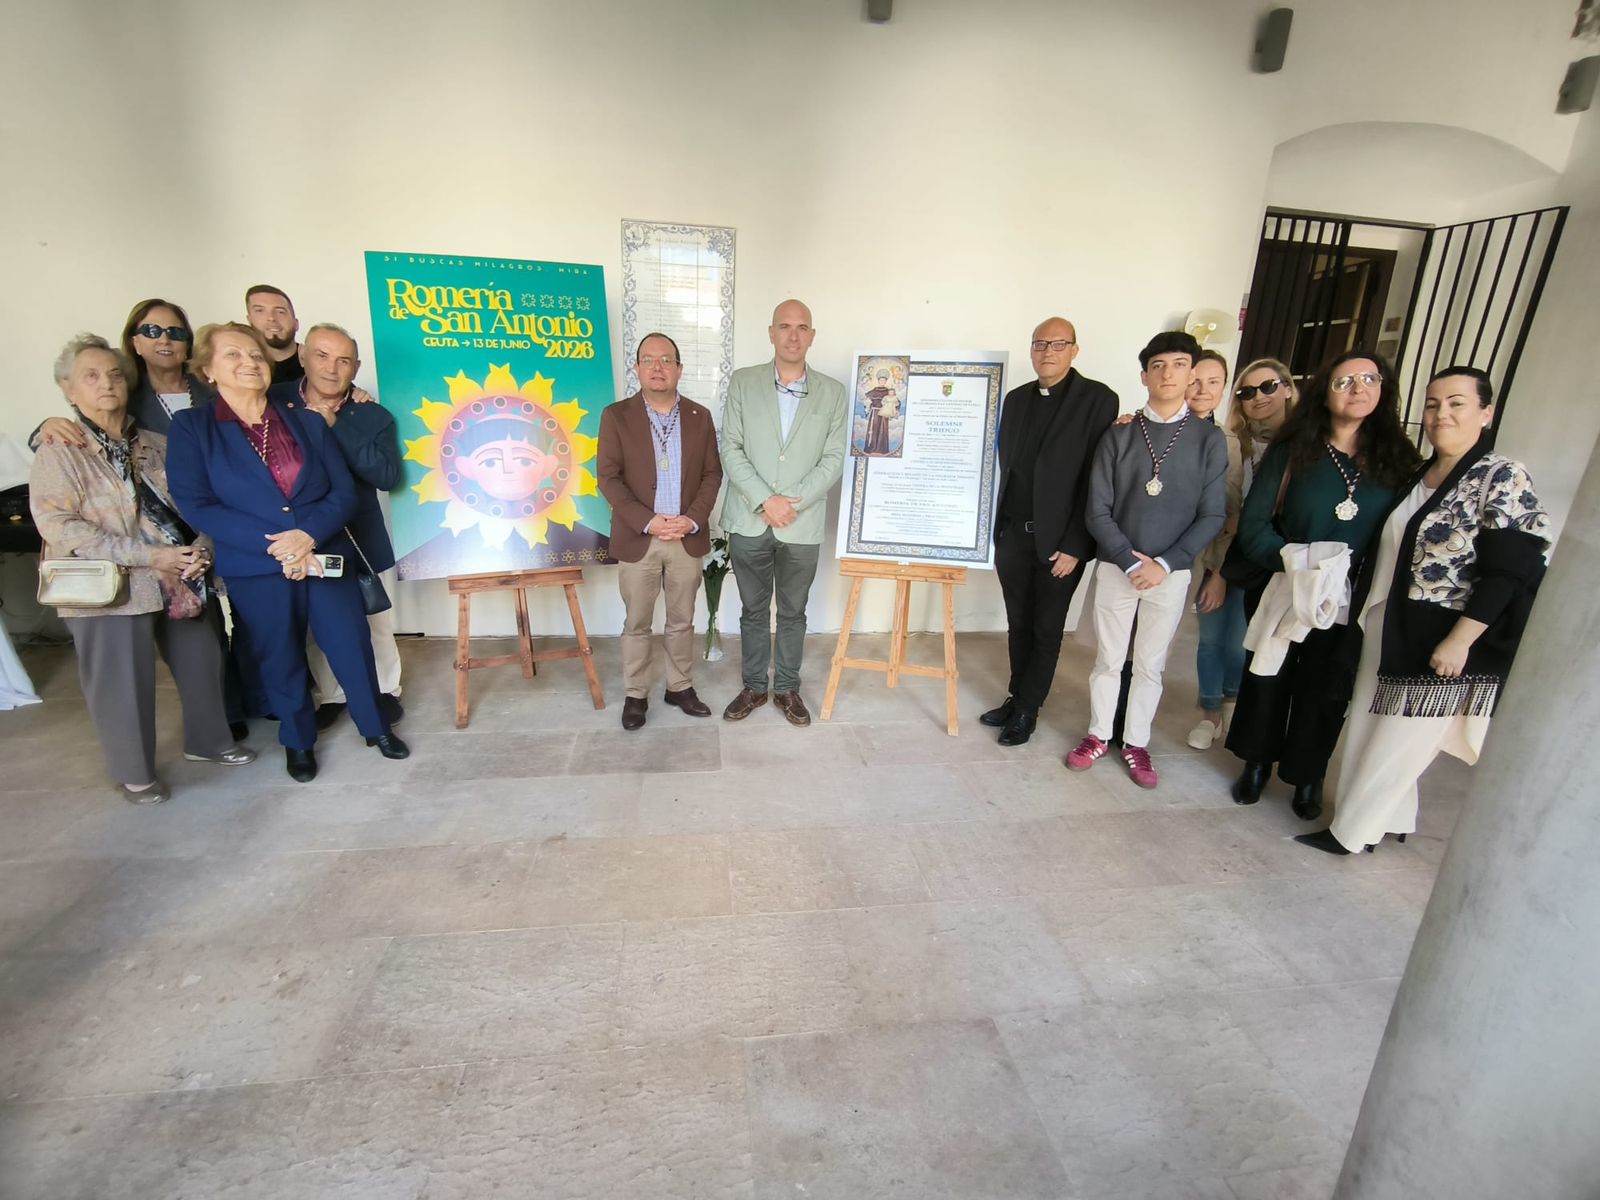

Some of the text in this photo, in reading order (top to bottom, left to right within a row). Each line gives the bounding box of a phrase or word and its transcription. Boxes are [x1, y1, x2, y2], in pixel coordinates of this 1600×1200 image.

[409, 256, 464, 266] BUSCAS
[385, 278, 514, 317] Romería
[389, 303, 593, 348] de San Antonio
[423, 337, 531, 350] CEUTA 13 DE JUNIO
[544, 339, 595, 359] 2026
